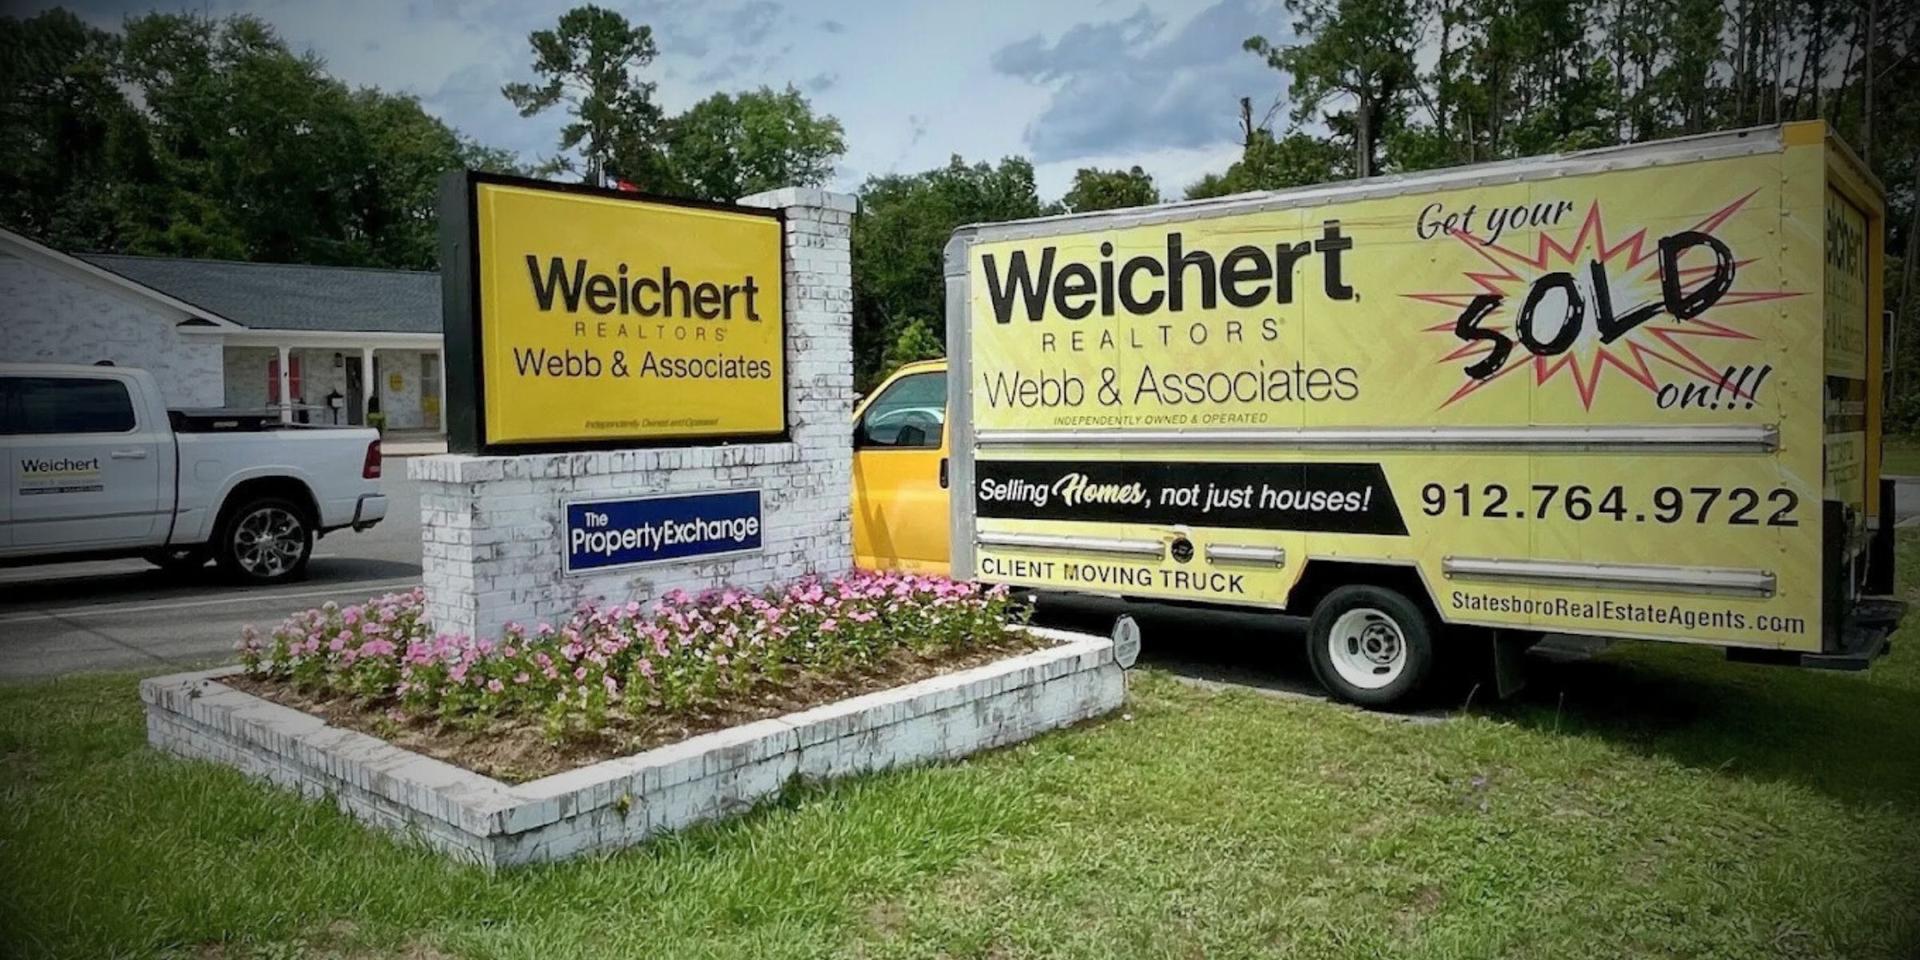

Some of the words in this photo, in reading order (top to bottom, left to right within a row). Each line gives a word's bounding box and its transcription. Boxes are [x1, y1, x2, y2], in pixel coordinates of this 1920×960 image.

[1416, 202, 1475, 240] Get
[1486, 199, 1574, 247] your
[1455, 231, 1736, 381] SOLD
[514, 347, 601, 378] Webb
[611, 351, 630, 378] &
[640, 351, 772, 380] Associates
[984, 369, 1085, 409] Webb
[1097, 367, 1122, 407] &
[1133, 359, 1359, 406] Associates
[1656, 365, 1772, 410] on!!!
[1054, 415, 1142, 426] INDEPENDENTLY
[1144, 414, 1188, 425] OWNED
[1190, 414, 1198, 424] &
[1202, 412, 1268, 424] OPERATED
[979, 478, 1049, 507] Selling
[1051, 472, 1151, 508] Homes,
[1160, 484, 1201, 507] not
[1202, 483, 1253, 513] just
[1259, 484, 1372, 512] houses!
[1421, 483, 1800, 528] 912.764.9722
[571, 520, 760, 557] PropertyExchange
[584, 511, 609, 527] The
[981, 557, 1054, 580] CLIENT
[1063, 563, 1153, 587] MOVING
[1159, 569, 1244, 594] TRUCK
[1452, 591, 1806, 635] StatesboroRealEstateAgents.com
